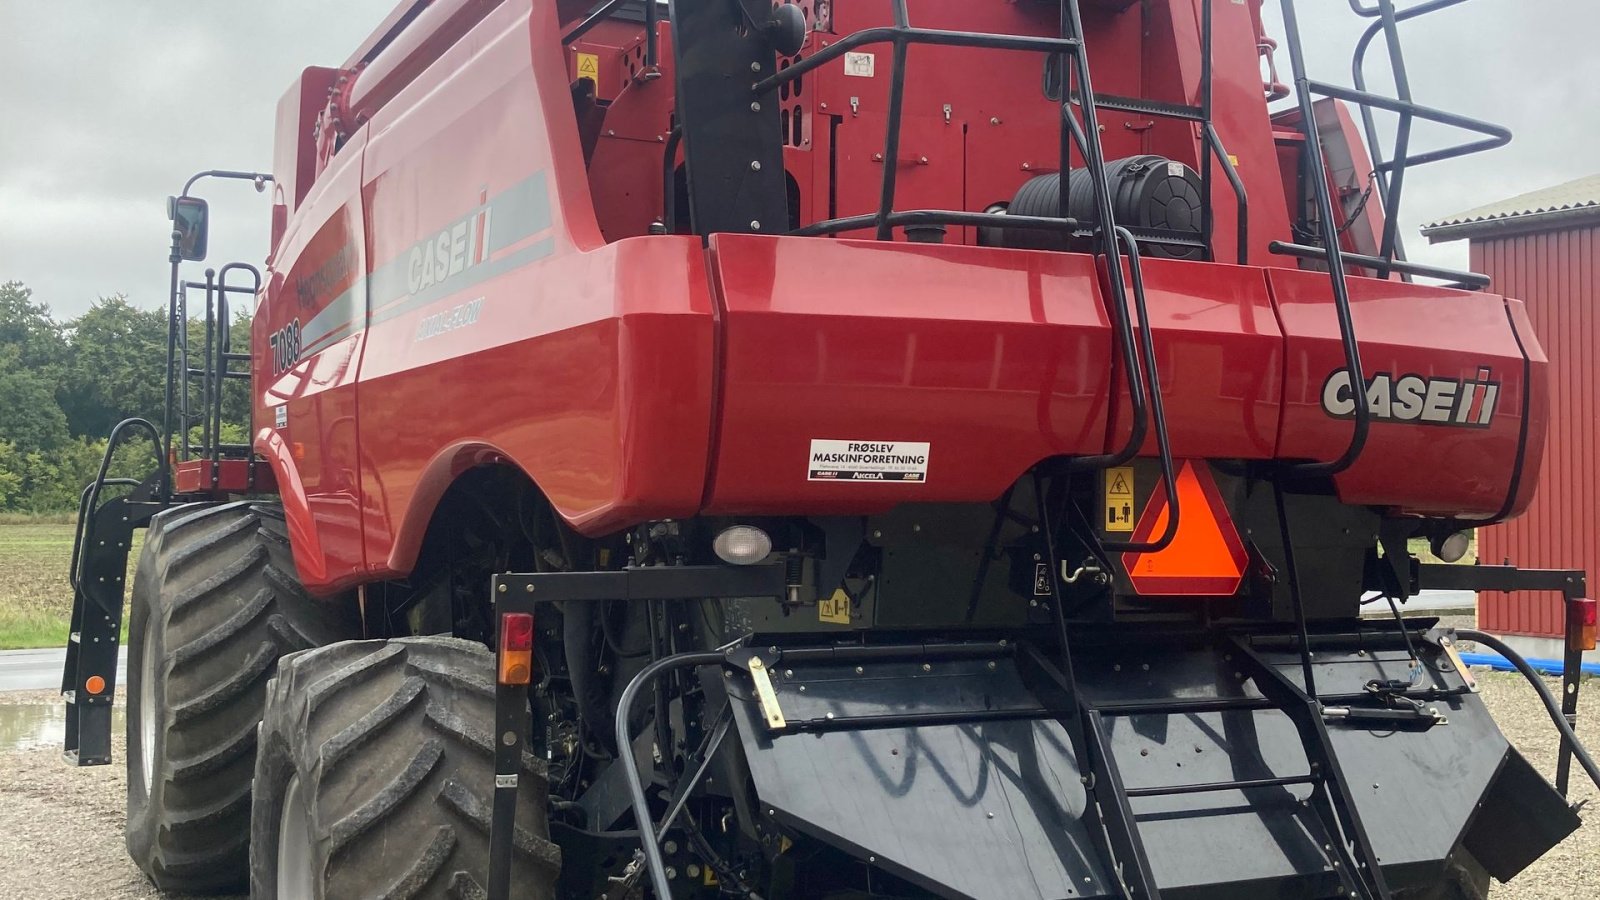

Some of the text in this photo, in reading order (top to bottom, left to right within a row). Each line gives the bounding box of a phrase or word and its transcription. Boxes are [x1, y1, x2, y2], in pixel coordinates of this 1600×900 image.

[269, 316, 300, 377] 7088
[847, 443, 894, 453] FRØSLEV
[813, 453, 925, 465] MASKINFORRETNING
